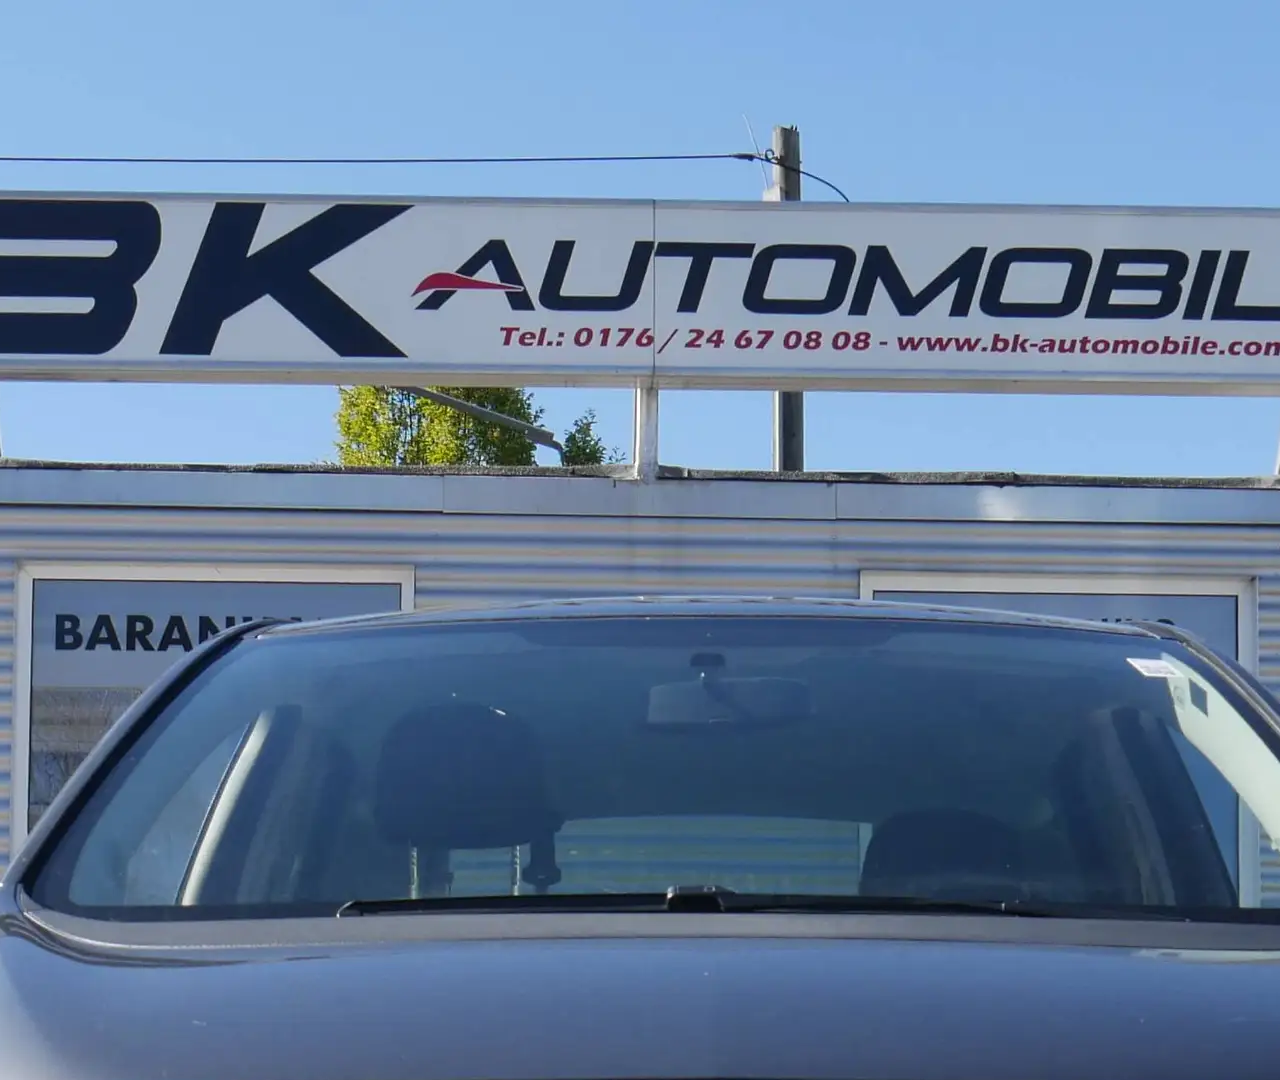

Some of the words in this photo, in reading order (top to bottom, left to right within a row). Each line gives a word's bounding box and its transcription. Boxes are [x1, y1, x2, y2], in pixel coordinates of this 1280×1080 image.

[499, 326, 565, 347] Tel.:
[573, 327, 655, 348] 0176
[684, 328, 725, 349] 24
[733, 330, 775, 350] 67
[782, 330, 822, 350] 08
[830, 331, 872, 351] 08
